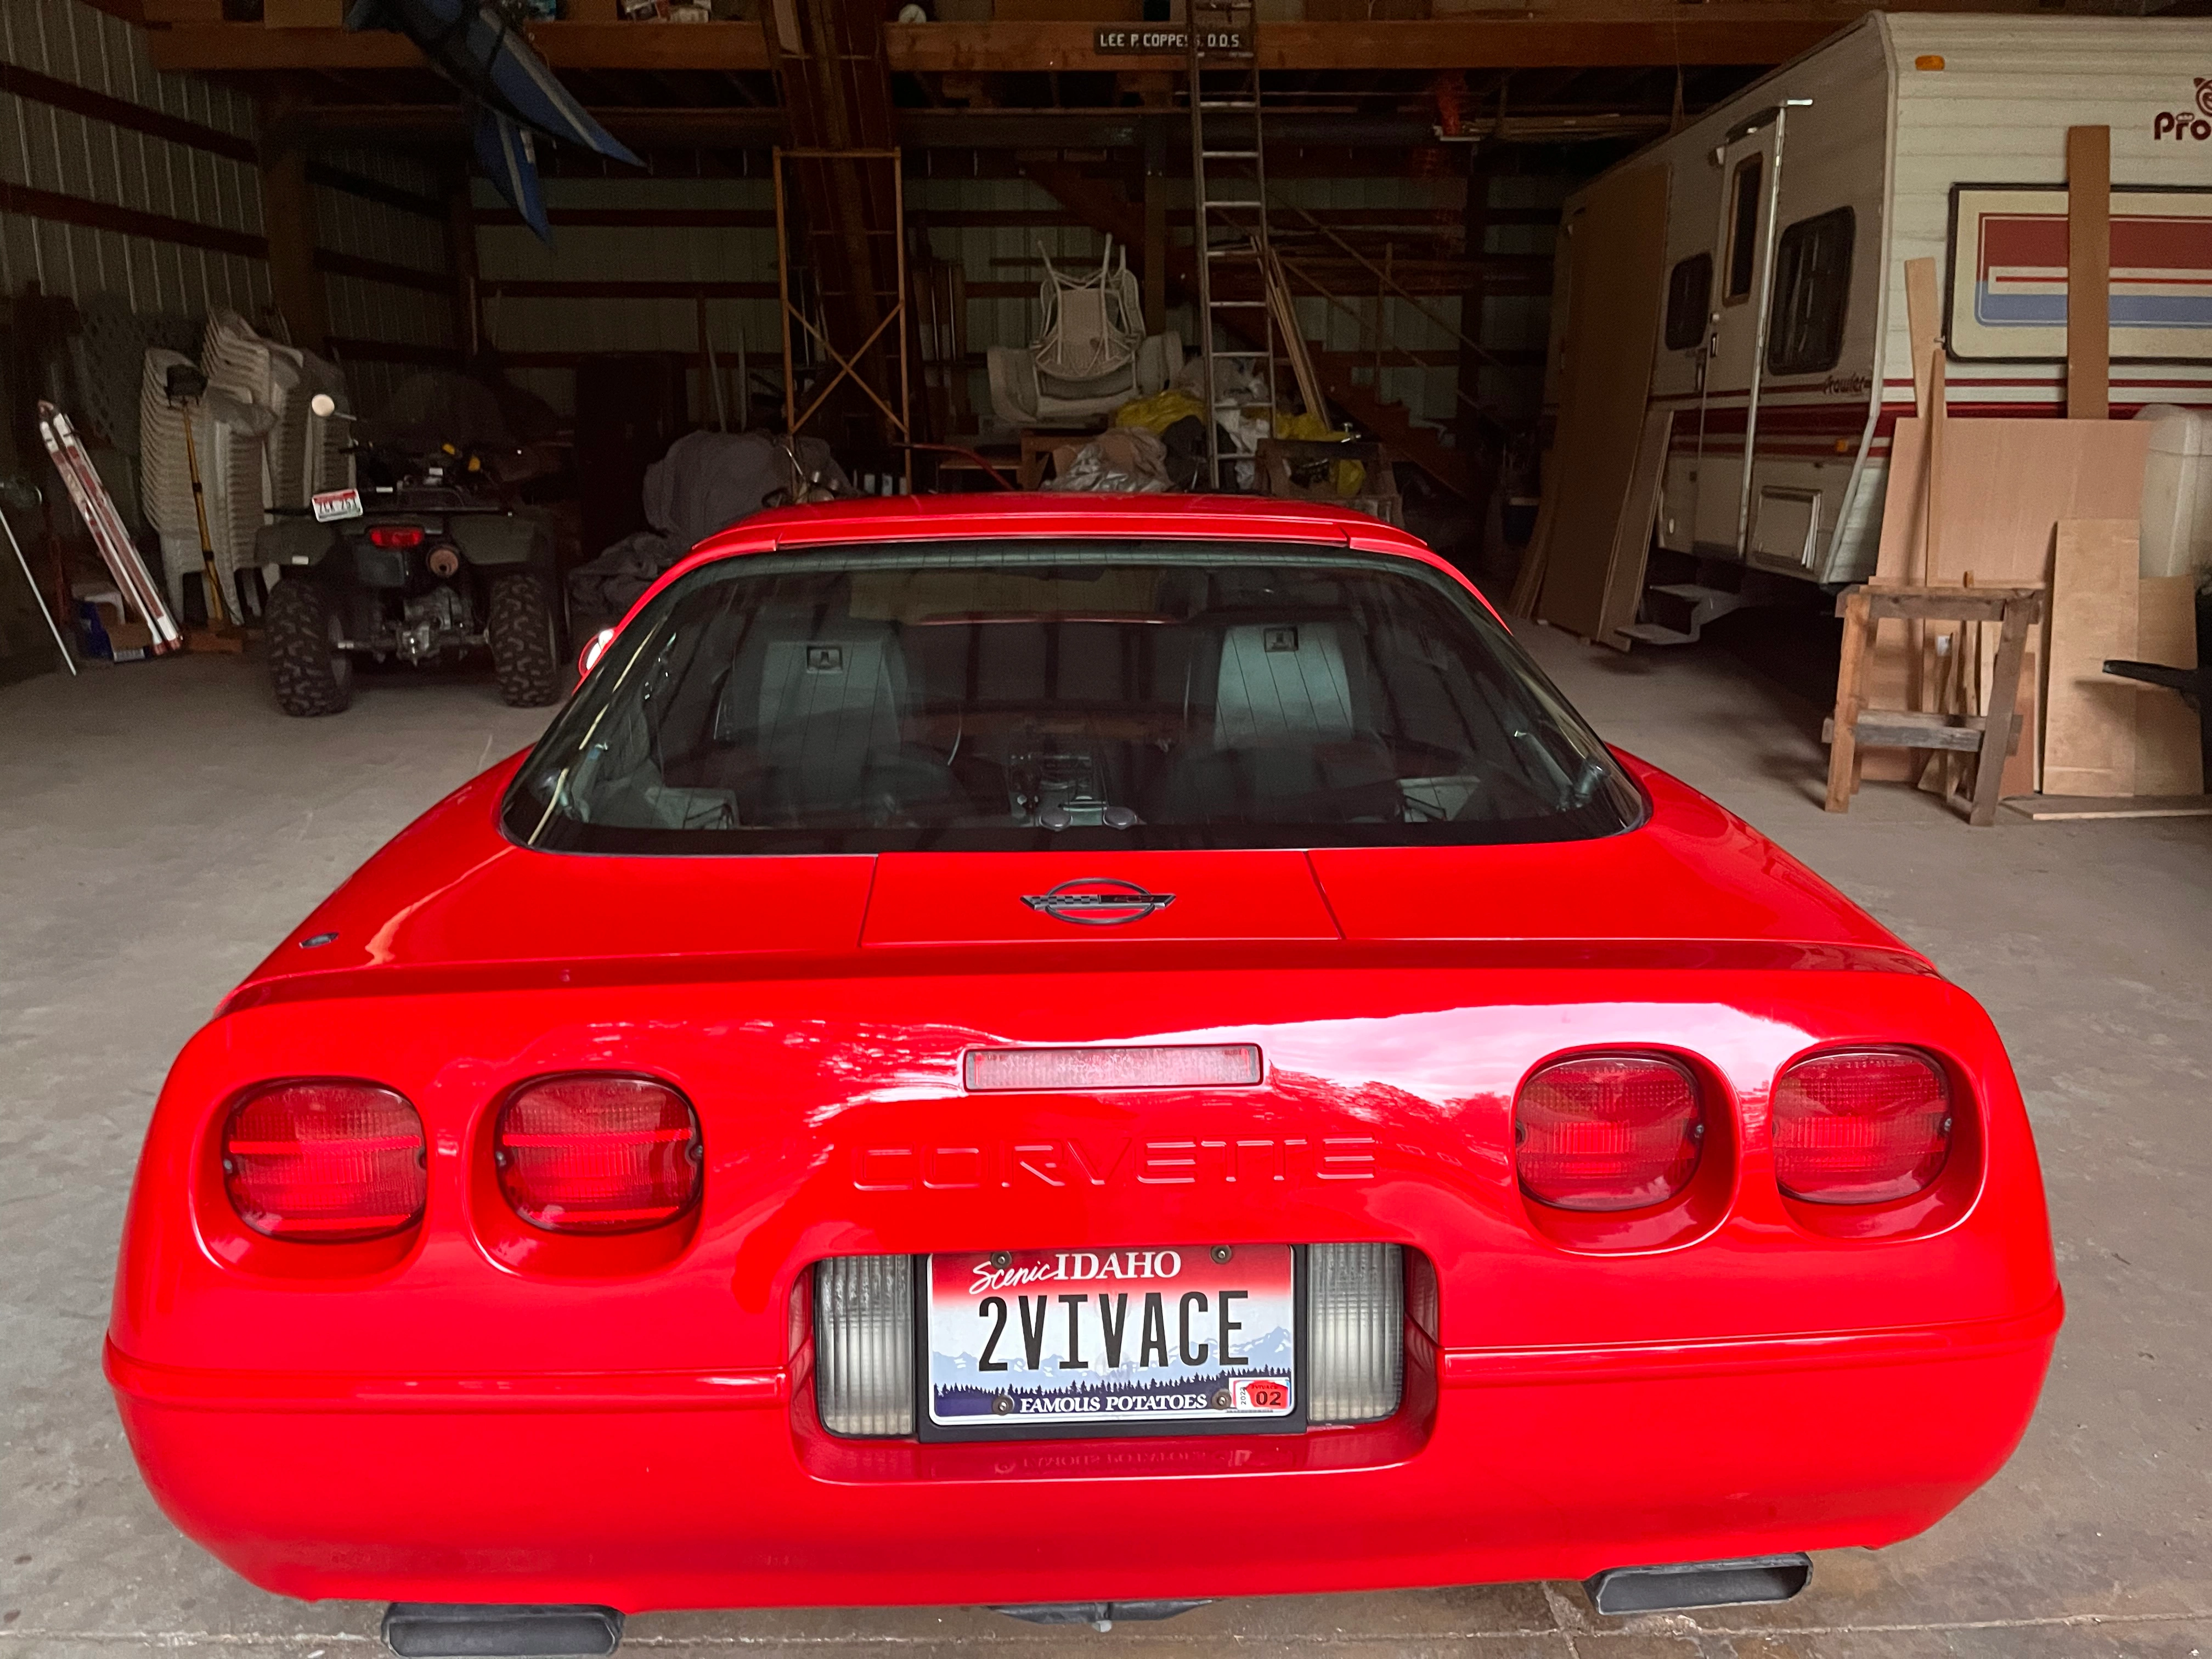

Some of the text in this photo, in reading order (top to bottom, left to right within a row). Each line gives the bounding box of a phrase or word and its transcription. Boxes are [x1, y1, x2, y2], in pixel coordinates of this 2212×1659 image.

[1100, 33, 1125, 47] LEE
[2154, 111, 2211, 140] Pro
[852, 1132, 1376, 1191] CORVETTE
[969, 1250, 1181, 1295] Scenic IDAHO
[978, 1290, 1249, 1372] 2VIVACE
[1020, 1393, 1207, 1413] FAMOUS POTATOES
[1256, 1391, 1282, 1406] 02
